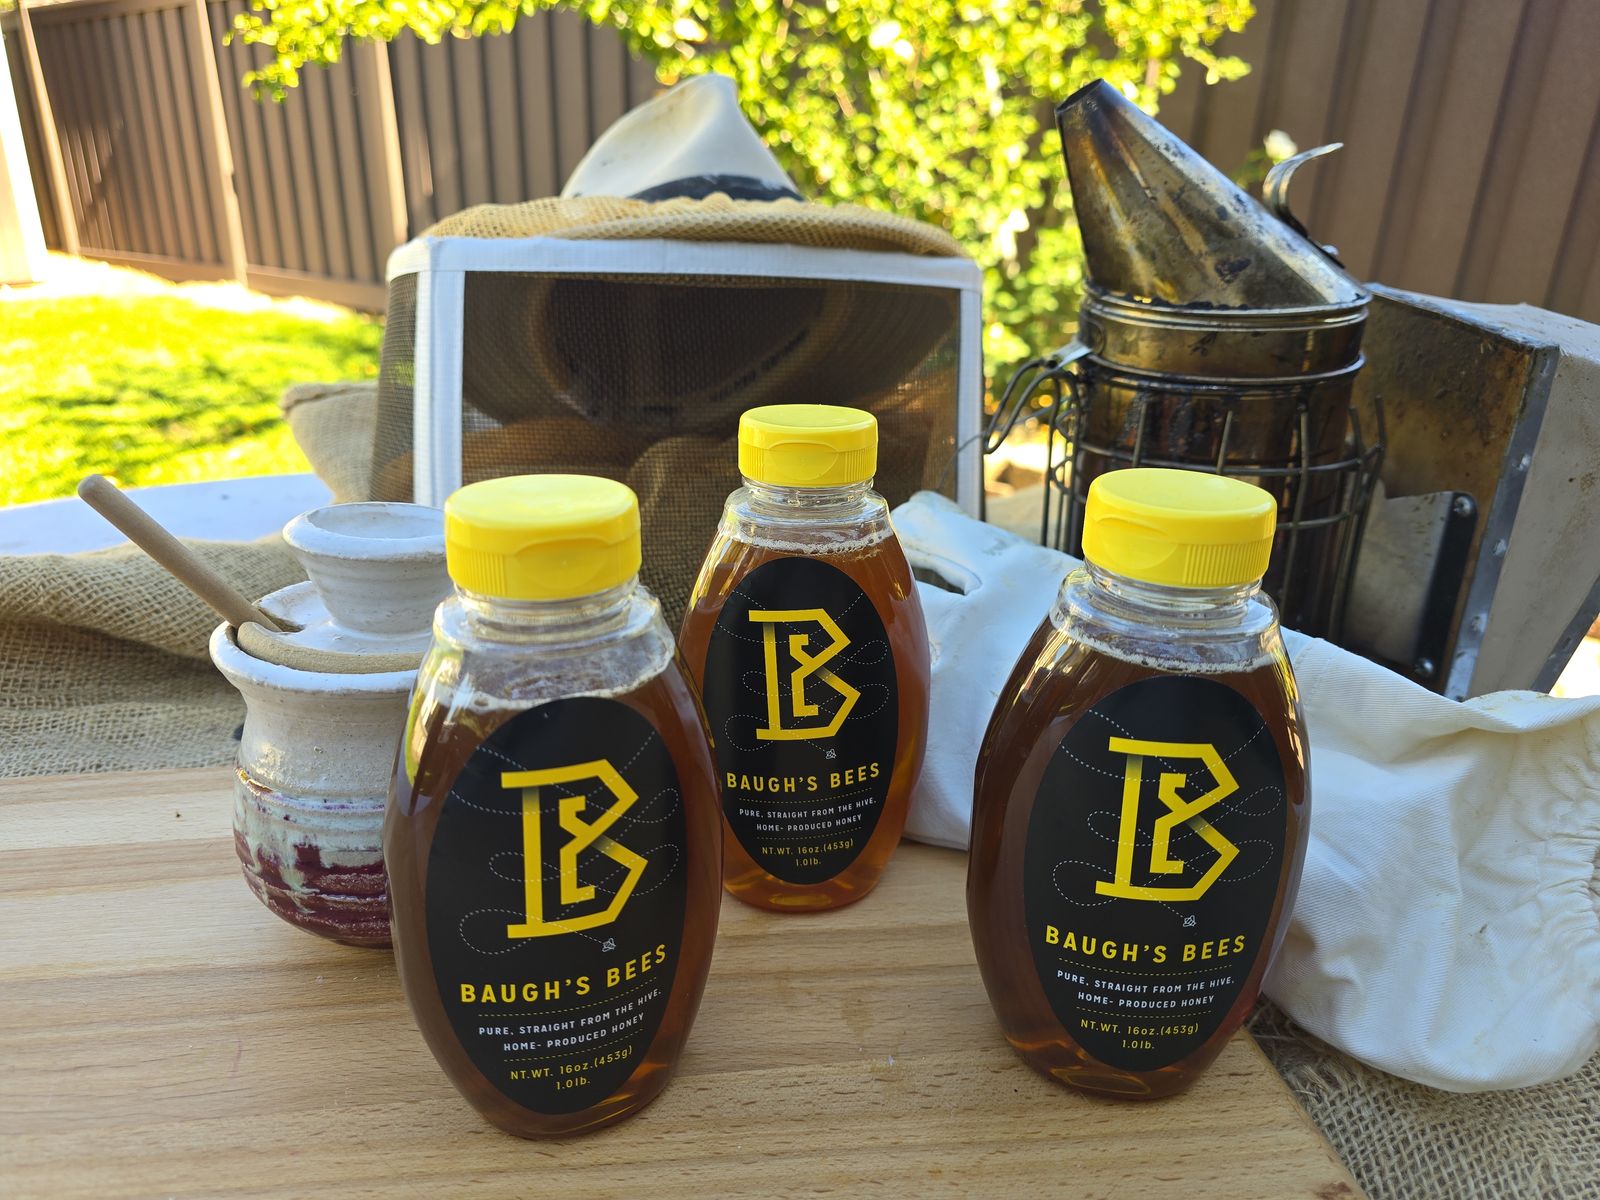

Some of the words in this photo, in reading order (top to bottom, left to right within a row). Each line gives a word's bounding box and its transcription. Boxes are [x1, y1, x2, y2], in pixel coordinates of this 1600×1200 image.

[726, 772, 818, 793] BAUGH'S
[830, 762, 880, 789] BEES
[767, 810, 808, 819] STRAIGHT
[811, 807, 834, 817] FROM
[838, 803, 853, 813] THE
[855, 797, 877, 809] HIVE.
[787, 821, 832, 831] PRODUCED
[835, 814, 862, 826] HONEY
[1045, 925, 1167, 963] BAUGH'S
[1182, 935, 1245, 962] BEES
[460, 975, 591, 1004] BAUGH'S
[606, 944, 666, 988] BEES
[1094, 979, 1148, 993] STRAIGHT
[1153, 984, 1182, 994] FROM
[1186, 981, 1205, 991] THE
[1209, 976, 1235, 988] HIVE.
[519, 1020, 575, 1035] STRAIGHT
[580, 1011, 610, 1027] FROM
[615, 1002, 633, 1016] THE
[637, 990, 662, 1006] HIVE.
[1118, 998, 1176, 1009] PRODUCED
[1181, 995, 1215, 1008] HONEY
[547, 1029, 607, 1049] PRODUCED
[611, 1012, 645, 1034] HONEY
